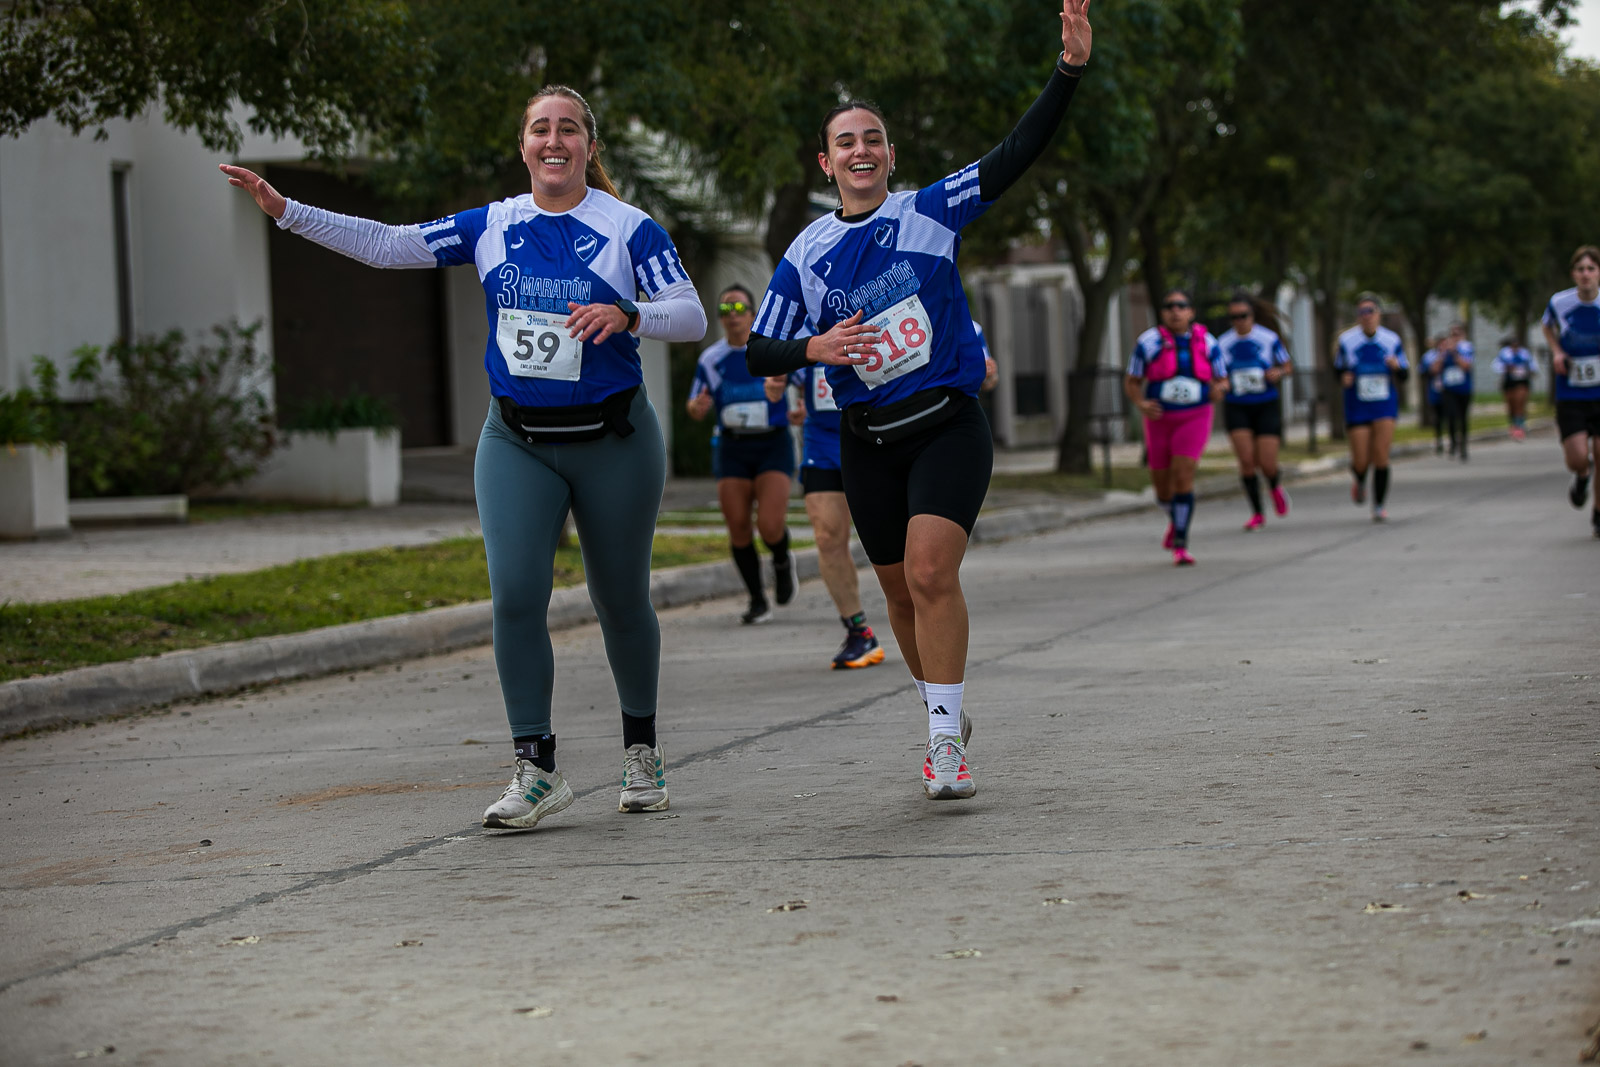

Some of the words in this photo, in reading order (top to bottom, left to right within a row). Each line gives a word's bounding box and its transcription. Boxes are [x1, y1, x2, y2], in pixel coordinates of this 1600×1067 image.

[497, 263, 519, 310] 3
[520, 276, 592, 301] MARATÓN
[847, 259, 915, 311] MARATÓN
[827, 288, 855, 323] 3
[512, 329, 561, 363] 59
[859, 317, 927, 373] 518
[816, 378, 834, 399] 5
